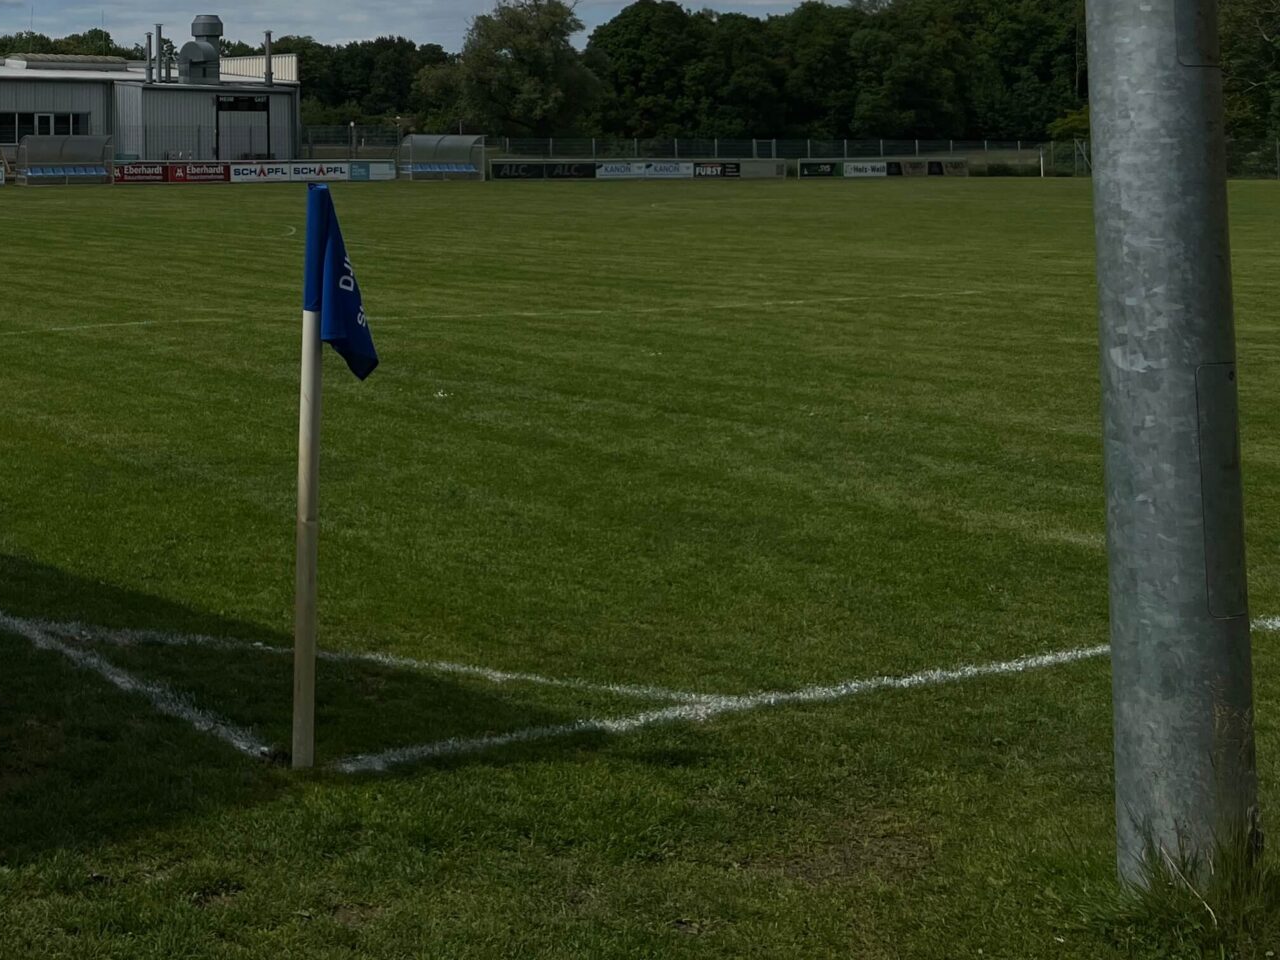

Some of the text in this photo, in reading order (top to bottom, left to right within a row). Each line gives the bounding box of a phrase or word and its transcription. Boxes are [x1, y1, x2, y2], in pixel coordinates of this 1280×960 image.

[124, 164, 163, 175] Eberhardt
[186, 164, 225, 175] Eberhardt
[500, 164, 528, 176] ALC
[553, 164, 579, 176] ALC
